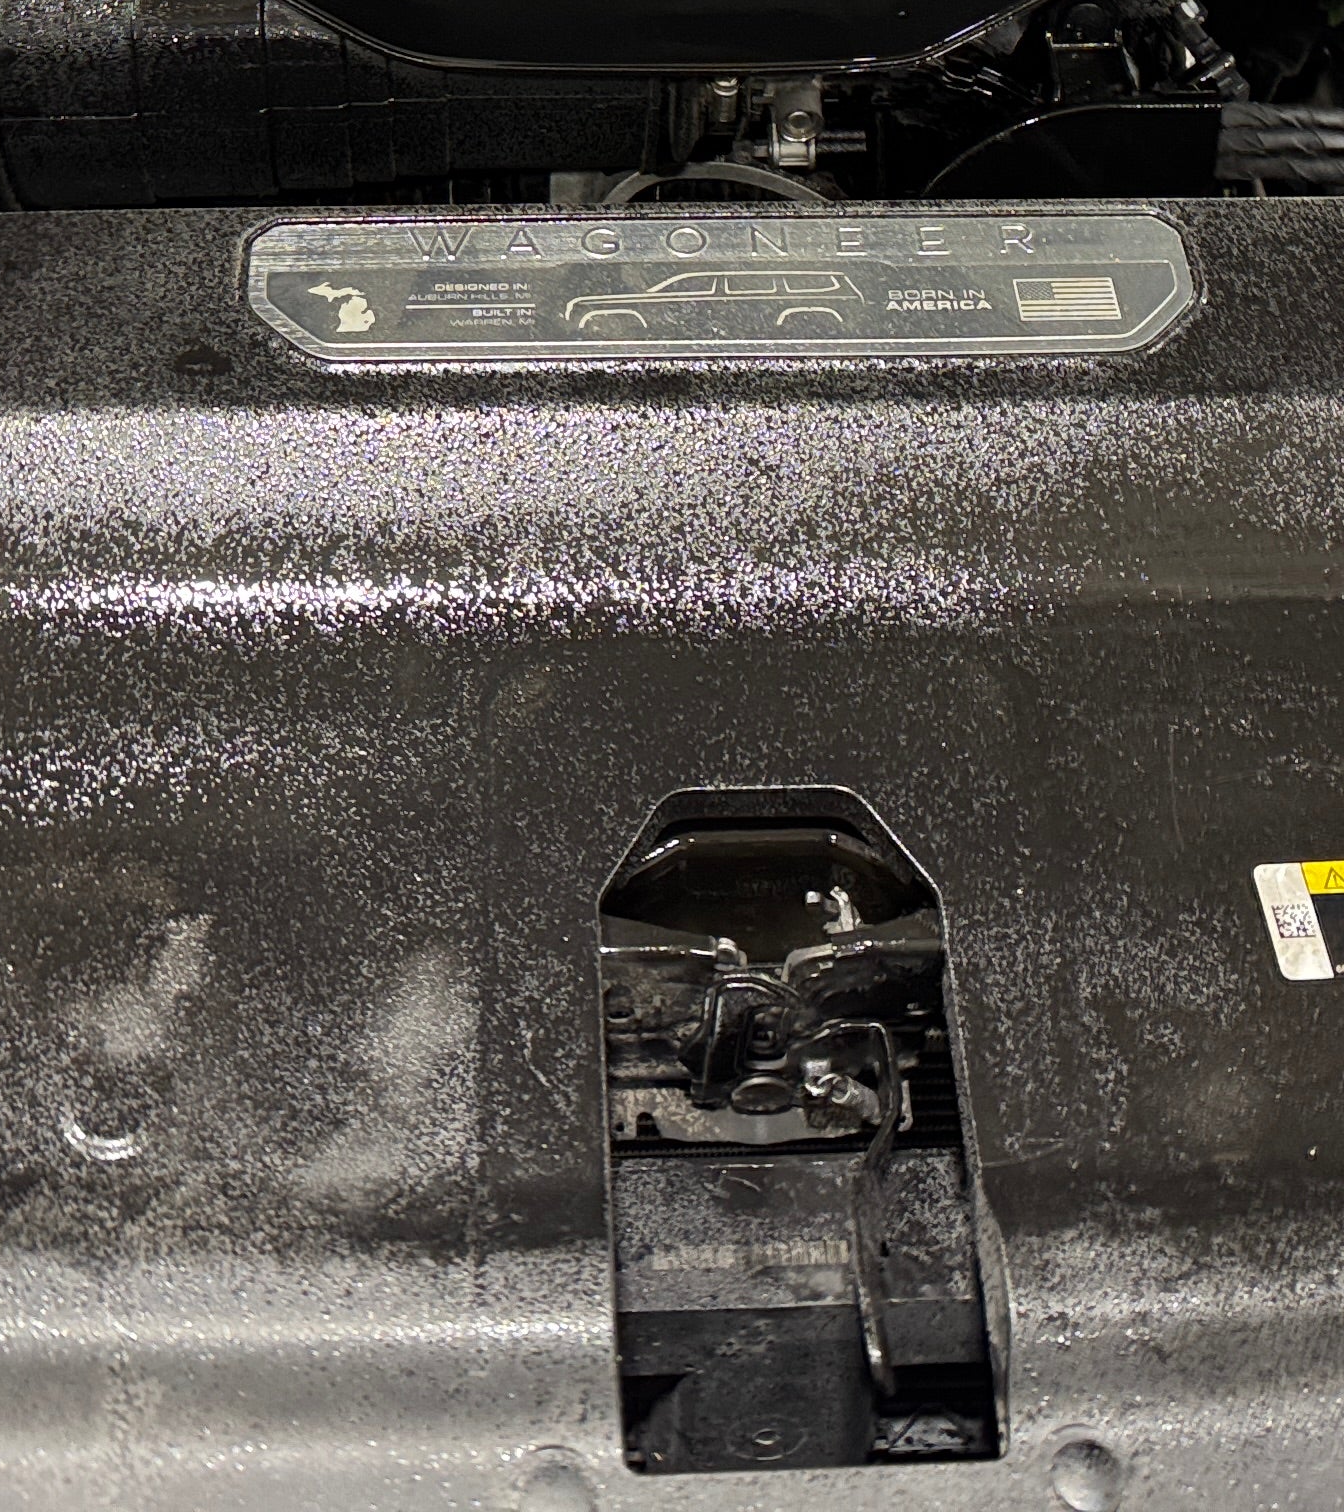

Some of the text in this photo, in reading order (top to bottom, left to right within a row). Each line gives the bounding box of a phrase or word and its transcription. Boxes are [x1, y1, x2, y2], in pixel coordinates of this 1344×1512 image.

[407, 225, 1034, 259] WAGONEER
[435, 283, 509, 291] DESIGNED
[888, 289, 986, 300] BORN IN
[886, 300, 993, 311] AMERICA
